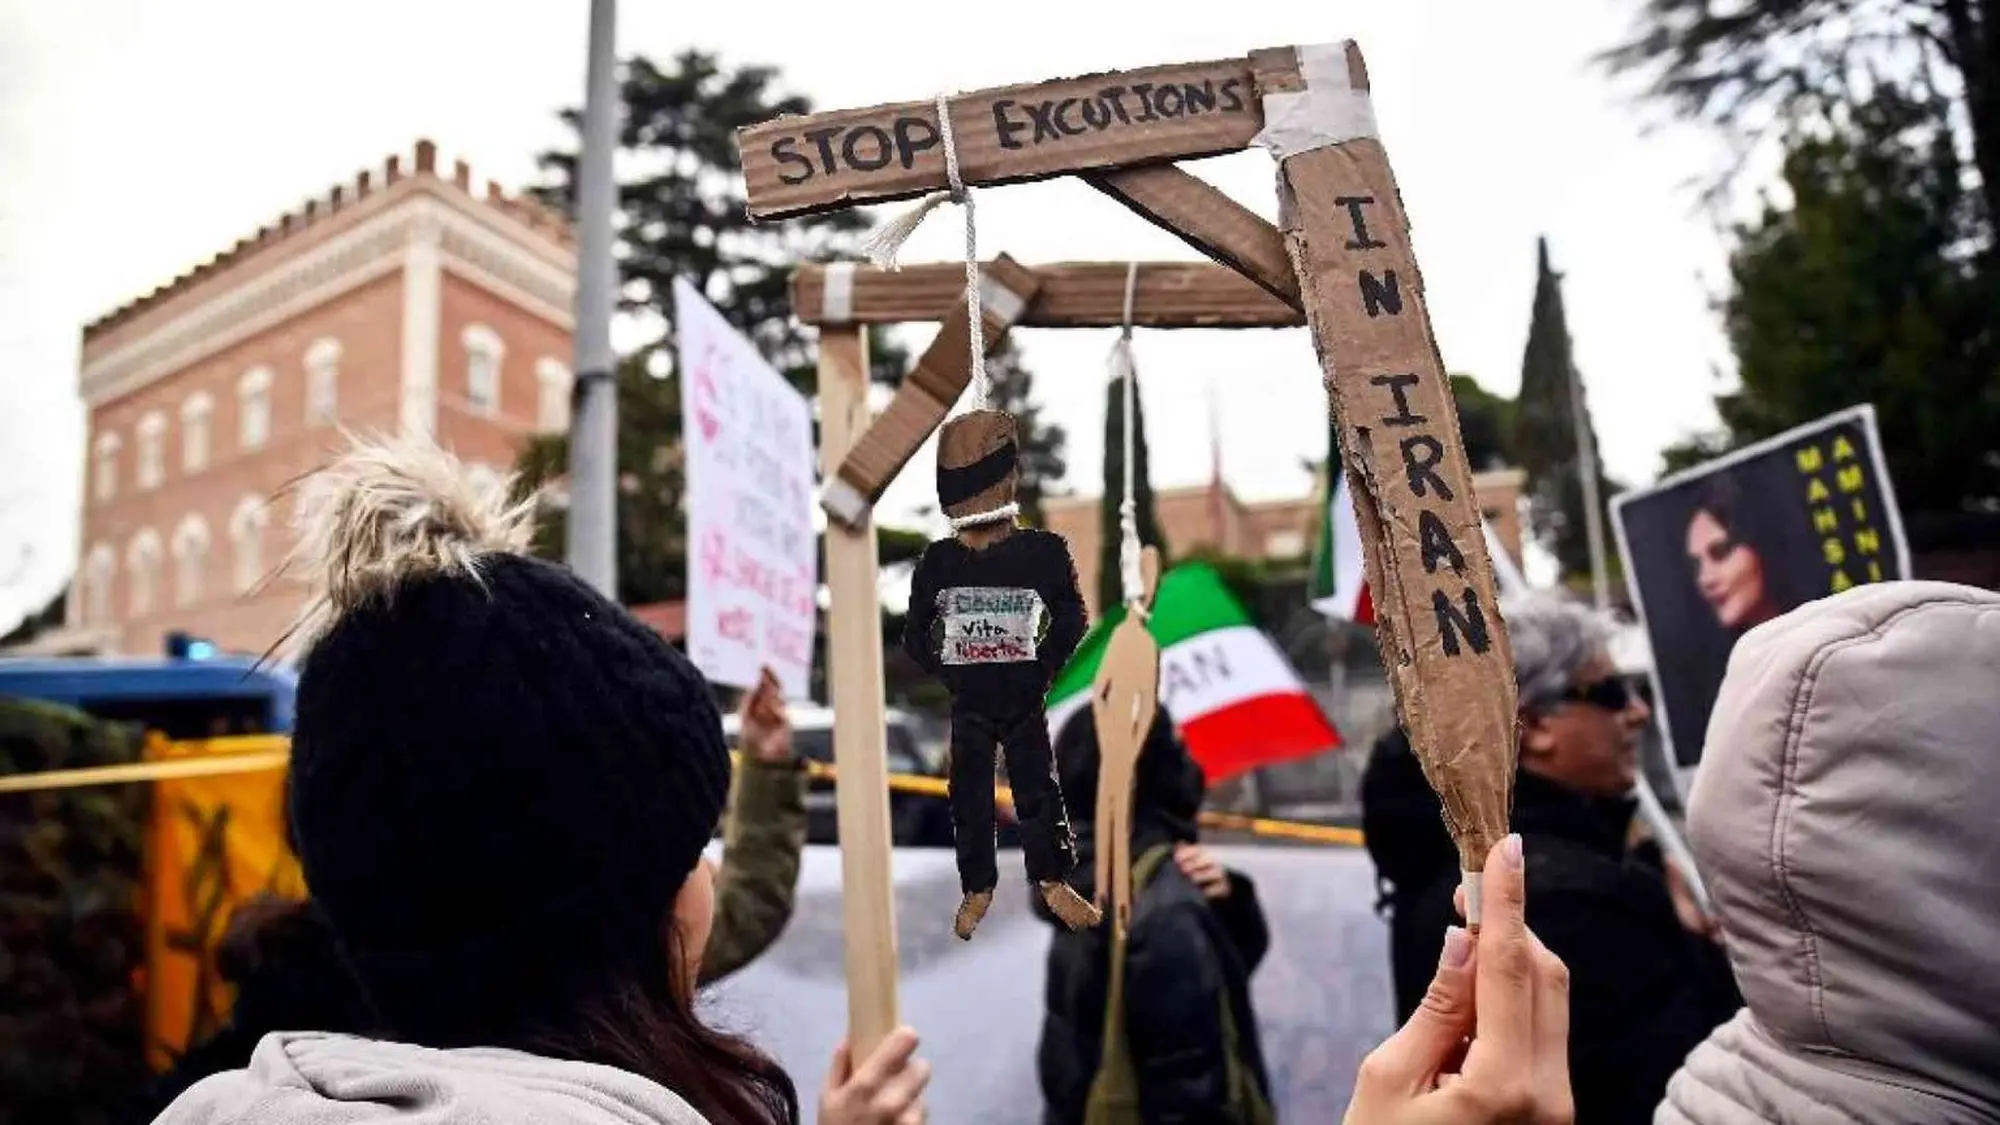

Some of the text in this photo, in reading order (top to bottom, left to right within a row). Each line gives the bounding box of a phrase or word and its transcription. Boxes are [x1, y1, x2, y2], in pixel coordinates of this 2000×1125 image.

[770, 77, 1246, 186] STOP EXCUTIONS
[1335, 196, 1492, 657] IN IRAN
[1796, 446, 1852, 593] MAHSA
[1832, 435, 1881, 582] AMINI
[1165, 644, 1232, 699] AN
